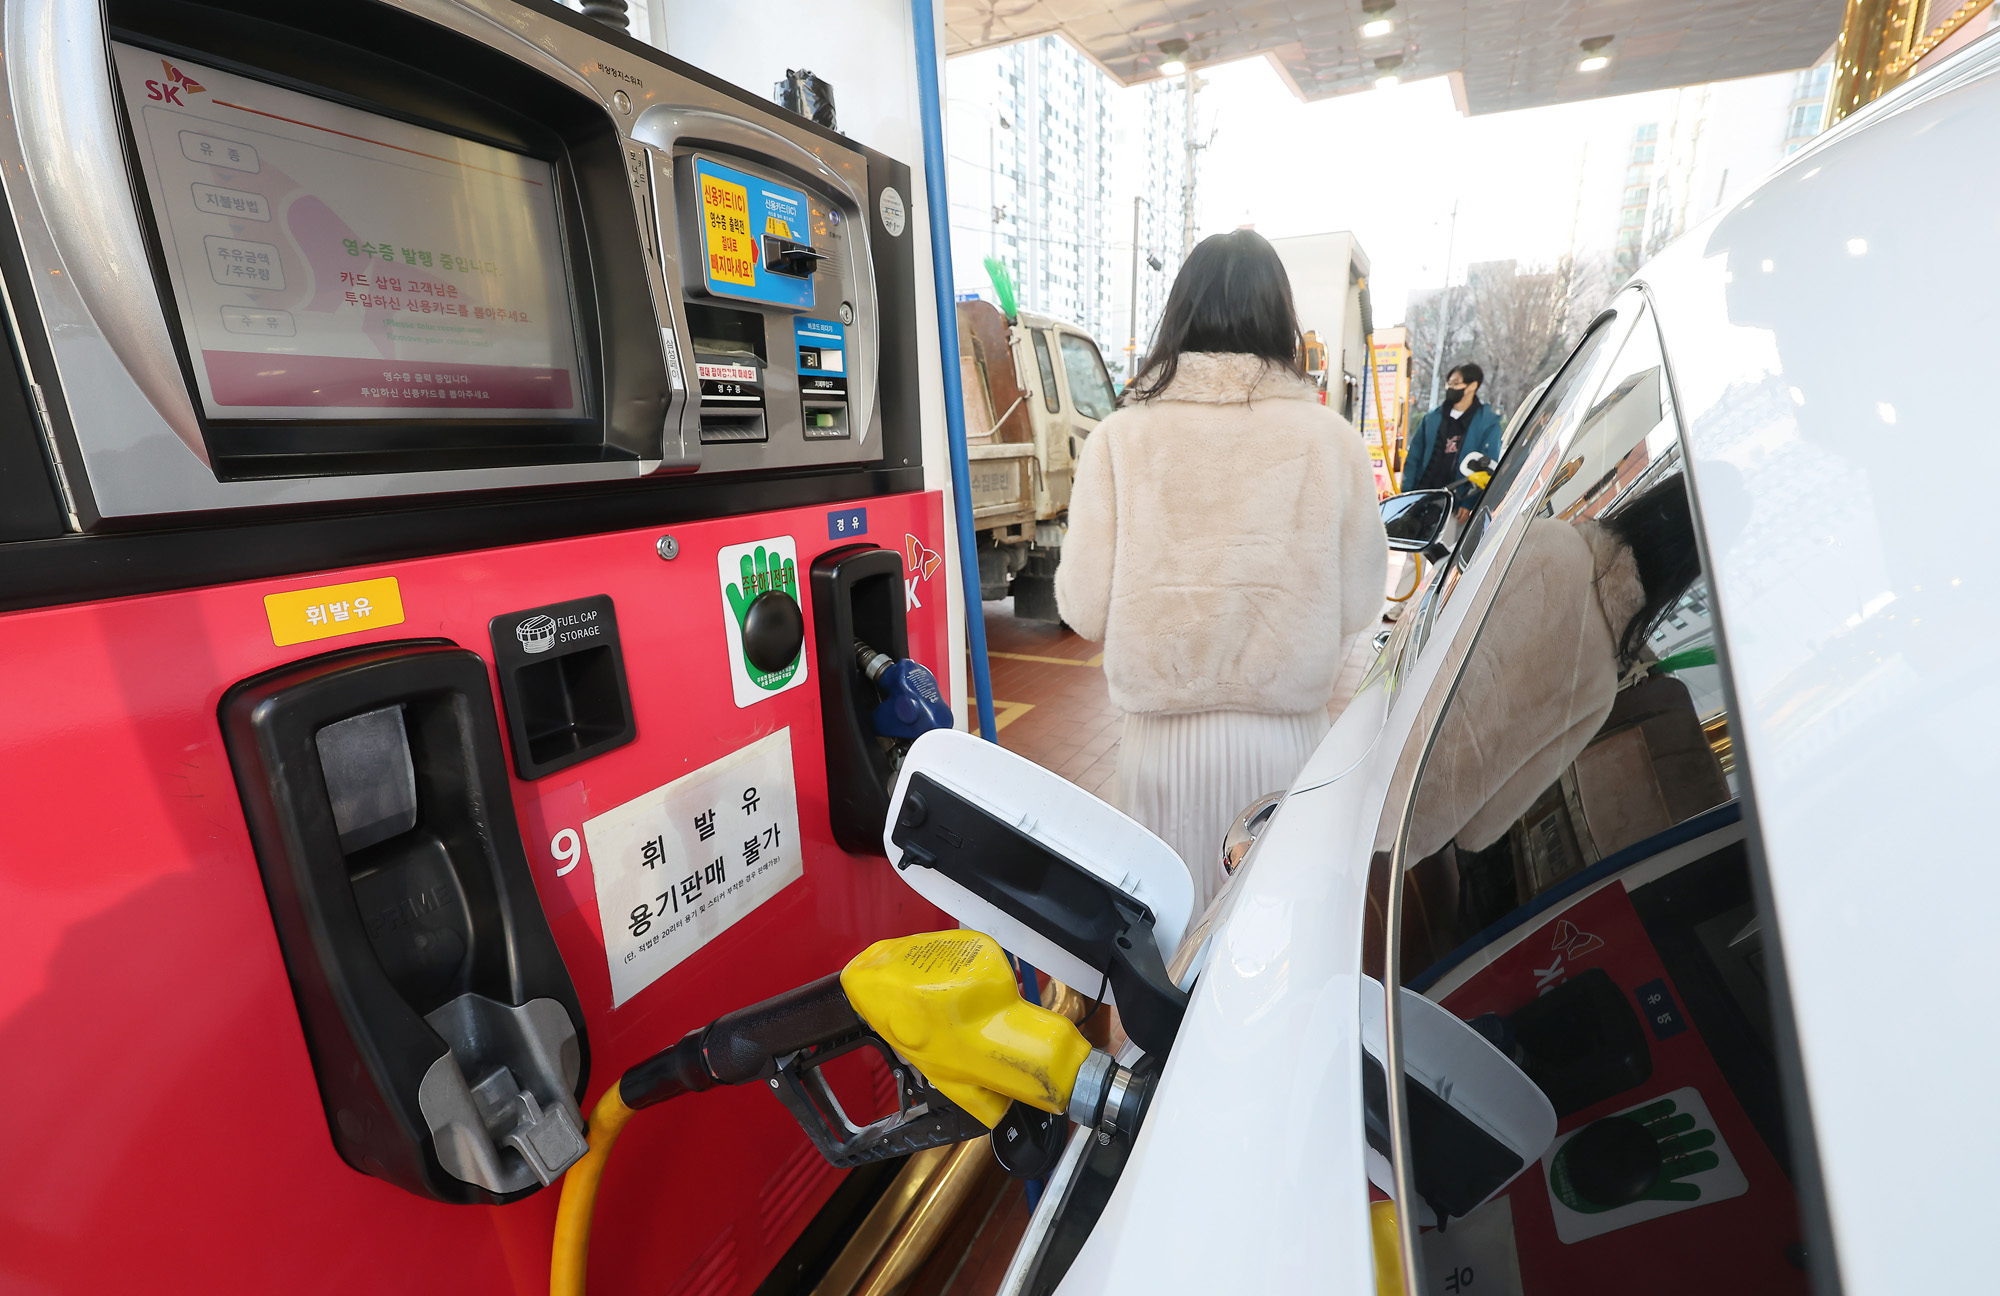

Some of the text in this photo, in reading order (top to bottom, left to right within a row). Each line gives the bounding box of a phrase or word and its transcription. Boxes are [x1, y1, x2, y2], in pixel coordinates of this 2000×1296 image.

[597, 62, 643, 88] 비상정지스위치
[145, 80, 184, 107] SK
[205, 193, 259, 213] 지불방법
[704, 184, 746, 213] 신용카드(IC)
[765, 198, 797, 216] 신용카드(IC)
[710, 212, 727, 231] 영수증
[218, 247, 270, 265] 주유금액
[722, 236, 738, 252] 절대로
[342, 238, 503, 277] 영수증 발행 중입니다.
[711, 253, 753, 278] 빼지마세요!
[340, 272, 458, 299] 카드 삽입 고객님은
[344, 291, 533, 324] 투입하신 신용카드를 뽑아주세요.
[383, 371, 411, 383] 영수증
[414, 373, 433, 383] 출력
[360, 387, 490, 399] 투입하신 신용카드를 뽑아주세요
[305, 597, 374, 626] 휘발유
[557, 610, 598, 628] FUEL CAP
[560, 625, 601, 643] STORAGE
[550, 828, 581, 878] 9
[628, 823, 781, 938] 용기판매 불가
[624, 952, 637, 964] (단,
[638, 934, 660, 953] 적법한
[661, 919, 683, 939] 20리터
[684, 909, 698, 924] 용기
[699, 904, 706, 914] 및
[707, 893, 726, 908] 스티커
[727, 879, 744, 895] 부착한
[745, 871, 757, 883] 경우
